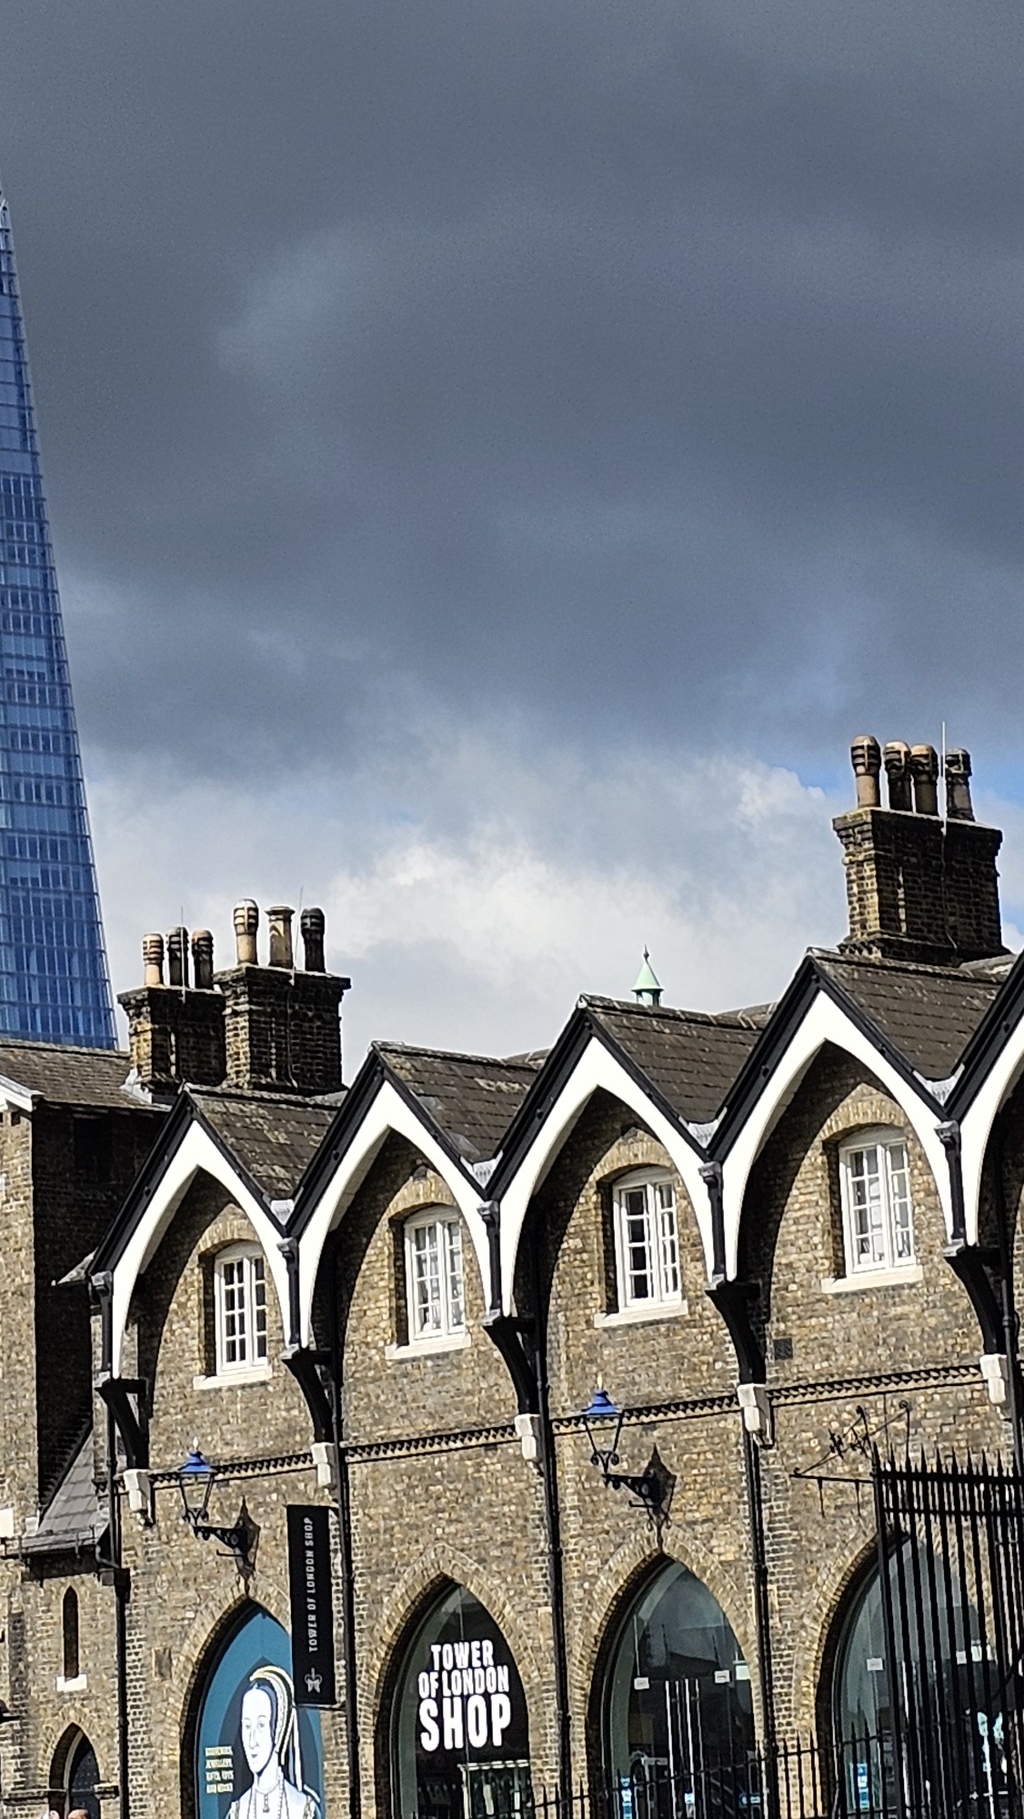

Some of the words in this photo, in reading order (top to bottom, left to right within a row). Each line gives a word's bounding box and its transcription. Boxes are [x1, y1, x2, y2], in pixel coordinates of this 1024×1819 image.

[303, 1517, 314, 1547] SHOP
[305, 1550, 316, 1594] LONDON
[306, 1597, 316, 1611] OF
[308, 1614, 318, 1653] TOWER
[430, 1639, 494, 1671] TOWER
[418, 1671, 439, 1699] OF
[441, 1665, 510, 1697] LONDON
[419, 1693, 511, 1752] SHOP
